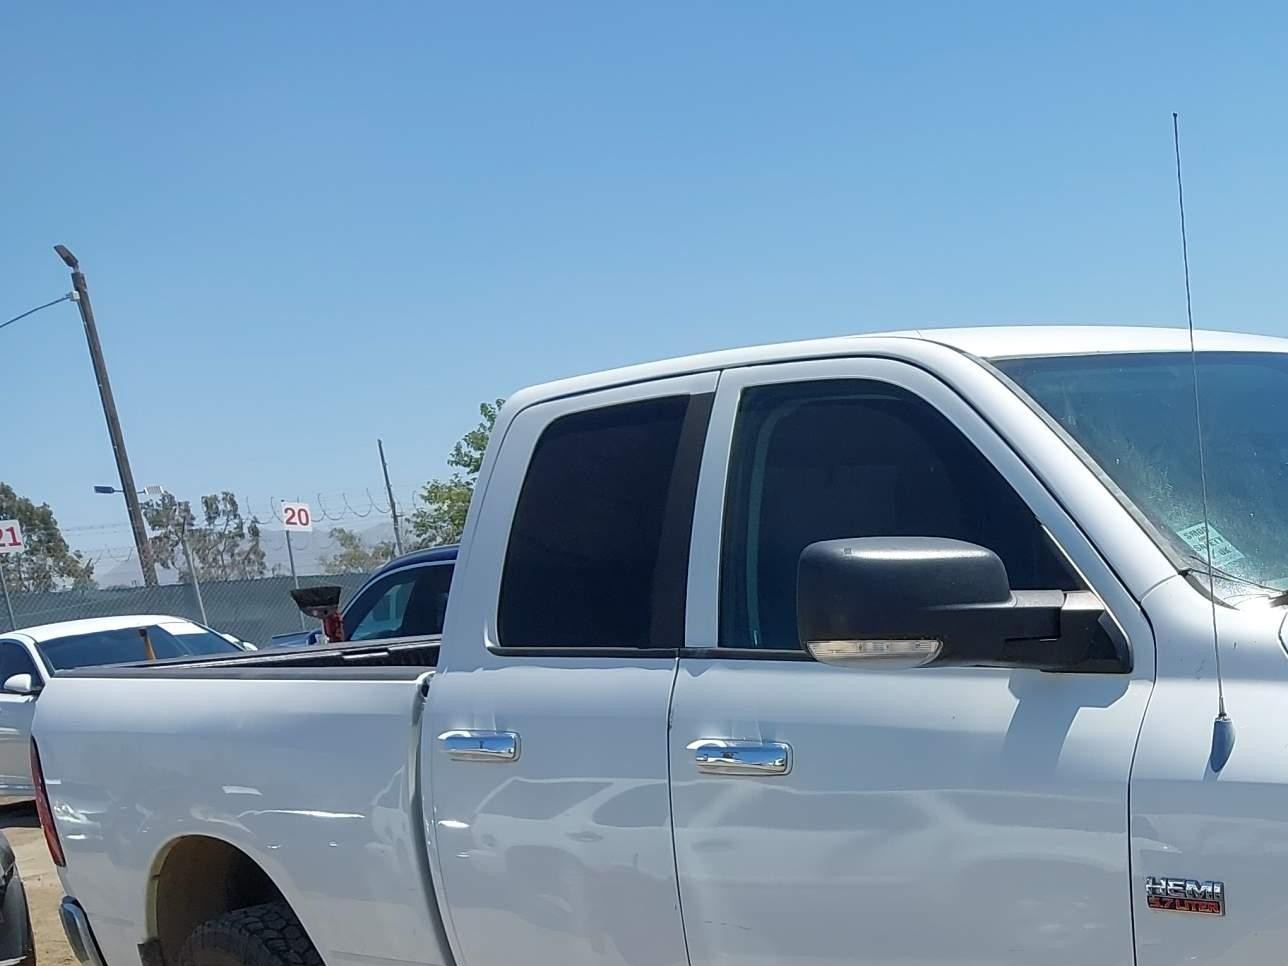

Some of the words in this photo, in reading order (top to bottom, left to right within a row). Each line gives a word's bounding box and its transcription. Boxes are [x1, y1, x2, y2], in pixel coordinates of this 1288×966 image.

[284, 507, 309, 526] 20
[1145, 877, 1223, 900] HEMI
[1175, 898, 1220, 913] LITER
